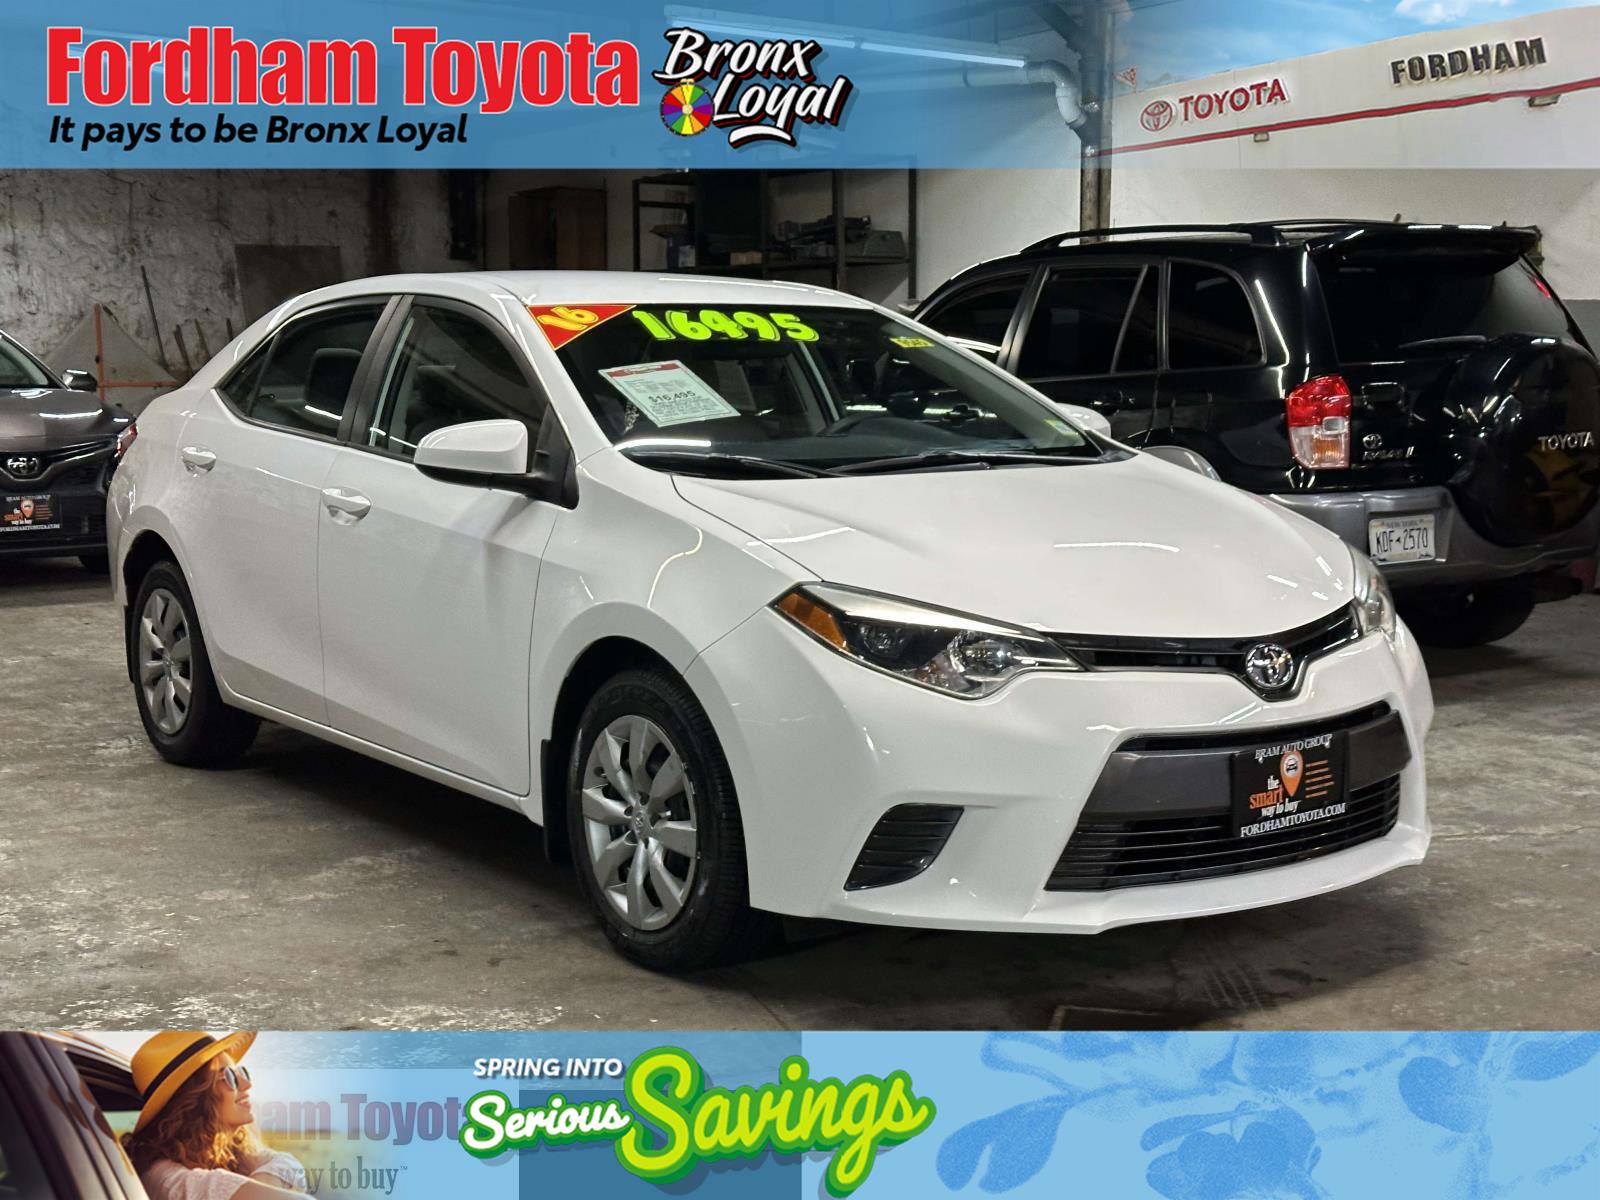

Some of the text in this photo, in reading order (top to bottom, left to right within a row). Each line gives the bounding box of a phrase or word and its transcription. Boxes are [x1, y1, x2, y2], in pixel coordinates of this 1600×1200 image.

[536, 305, 600, 332] 16
[631, 309, 820, 342] 16495
[1538, 431, 1595, 452] TOYOTA
[1281, 740, 1304, 754] AUTO
[1267, 775, 1279, 790] the
[1249, 784, 1284, 809] smart
[1261, 798, 1299, 817] way to buy
[1240, 803, 1346, 837] FORDHAMTOYOTA.COM
